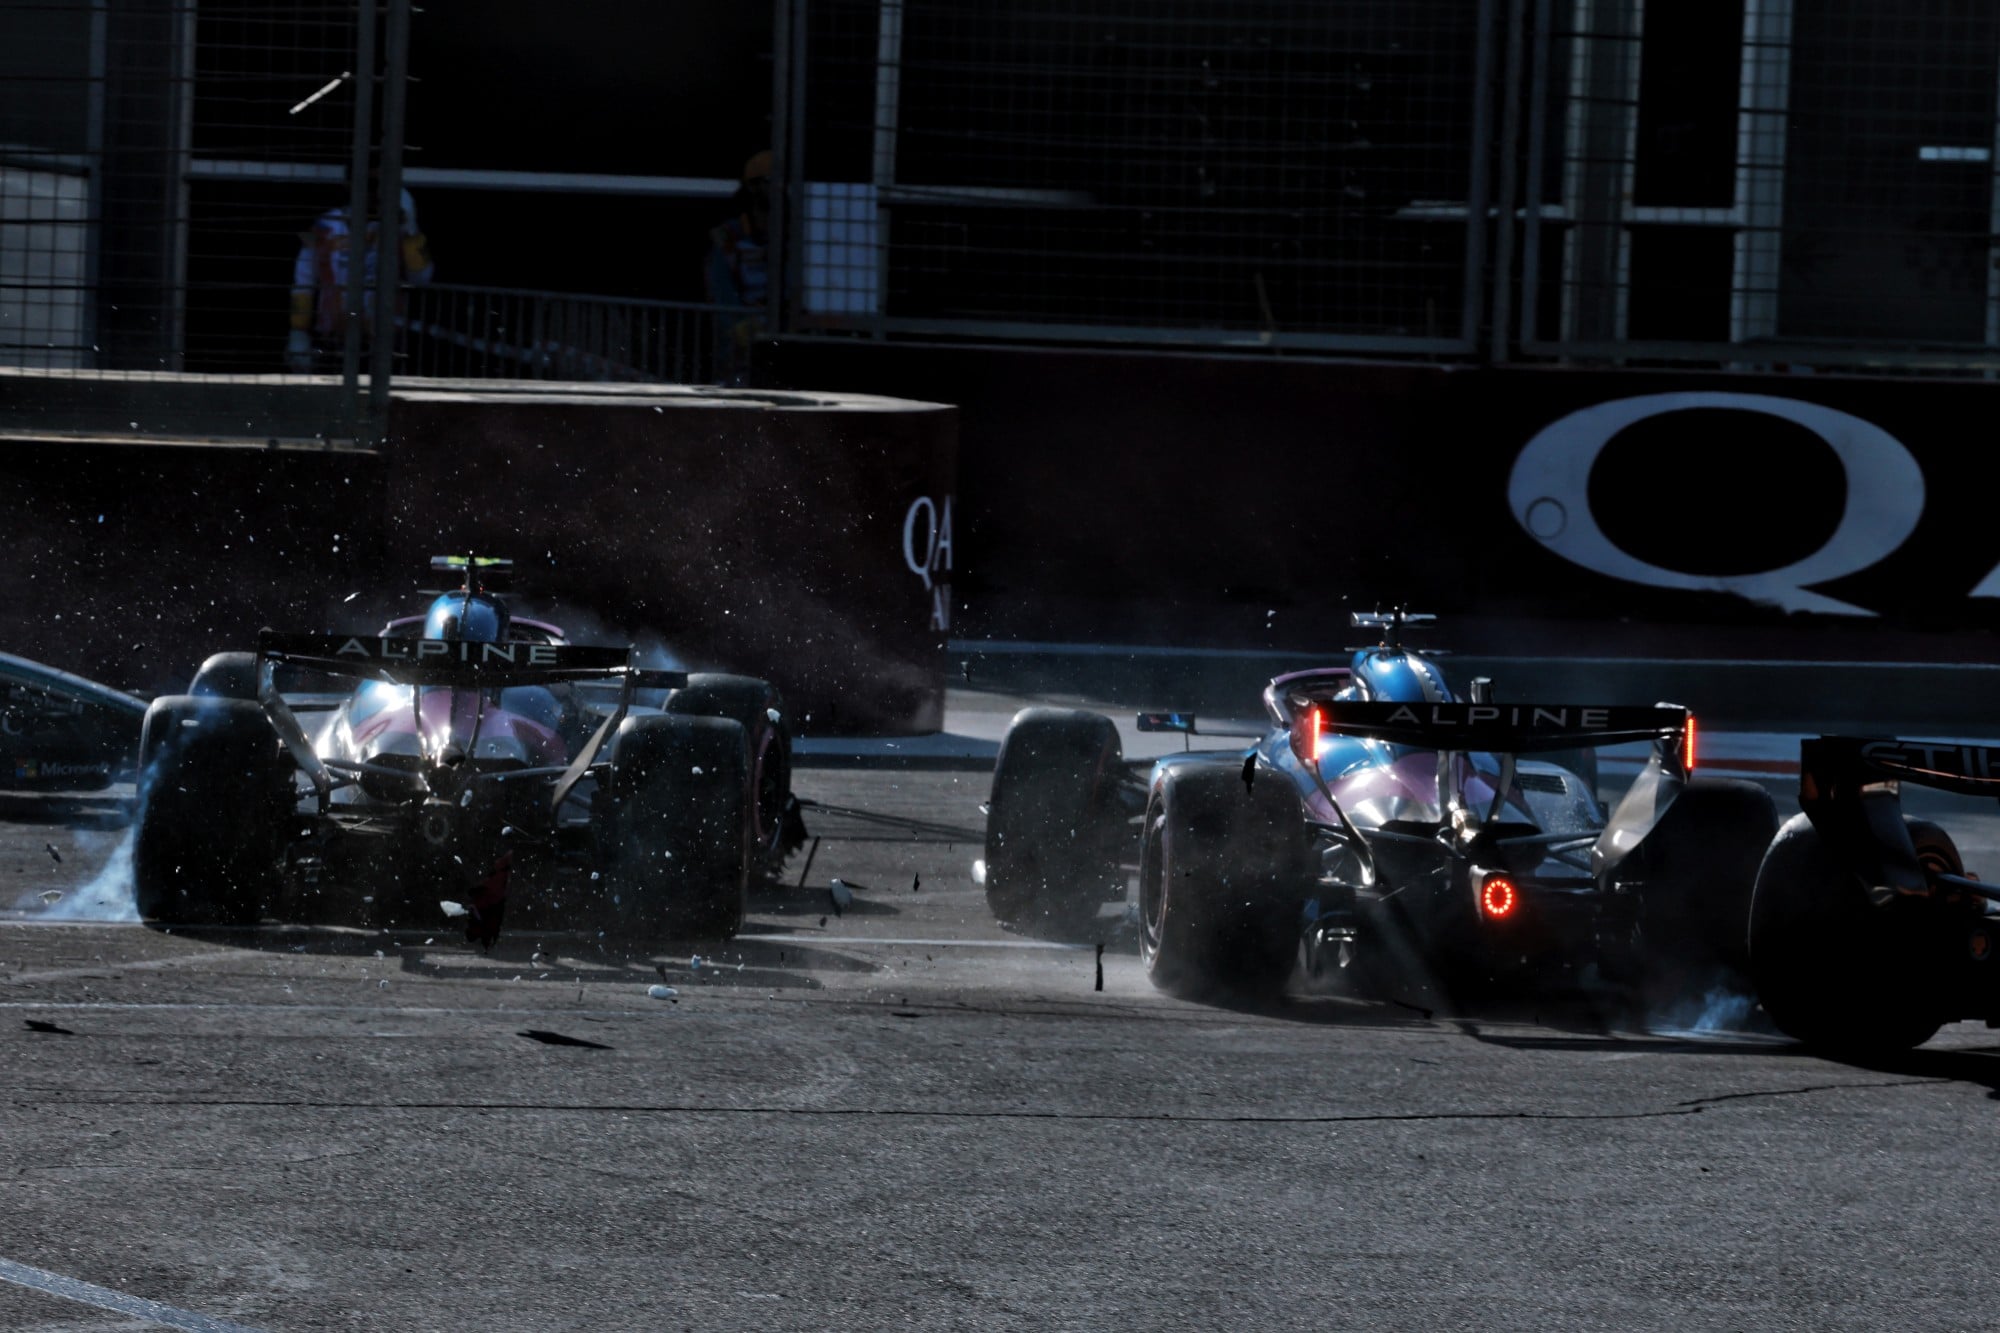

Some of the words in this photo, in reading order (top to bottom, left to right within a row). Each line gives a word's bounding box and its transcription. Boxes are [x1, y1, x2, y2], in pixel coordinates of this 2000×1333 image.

[1506, 390, 2000, 618] Q
[336, 637, 560, 665] ALPINE
[1385, 705, 1612, 729] ALPINE
